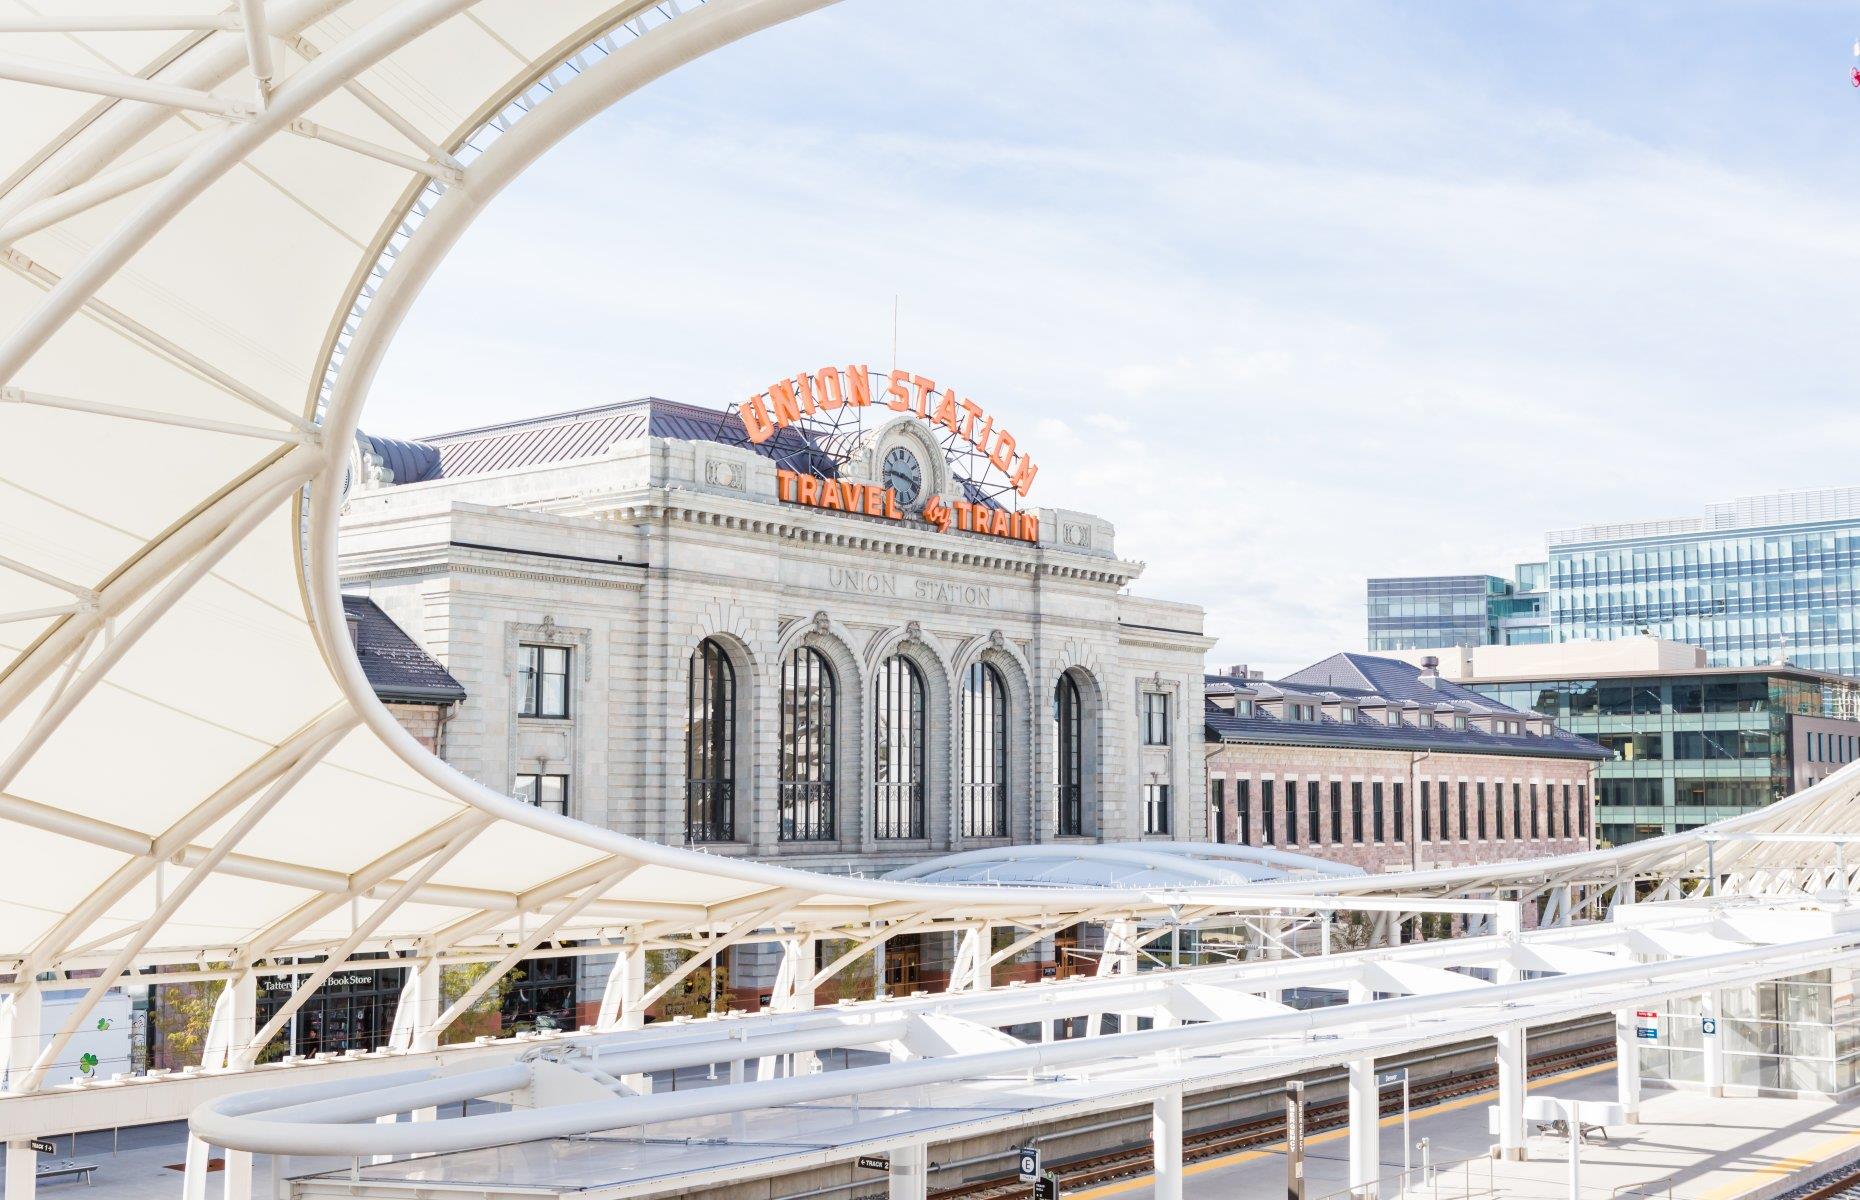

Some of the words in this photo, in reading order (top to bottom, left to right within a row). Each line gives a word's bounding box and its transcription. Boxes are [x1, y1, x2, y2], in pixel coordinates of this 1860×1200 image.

[739, 365, 871, 443] UNION
[887, 369, 1038, 497] STATION
[777, 469, 904, 520] TRAVEL
[922, 494, 952, 533] by
[953, 500, 1038, 542] TRAIN
[829, 568, 896, 596] UNION
[915, 579, 990, 607] STATION
[327, 976, 350, 986] Book
[350, 974, 372, 985] Store
[866, 1160, 882, 1168] TRACK
